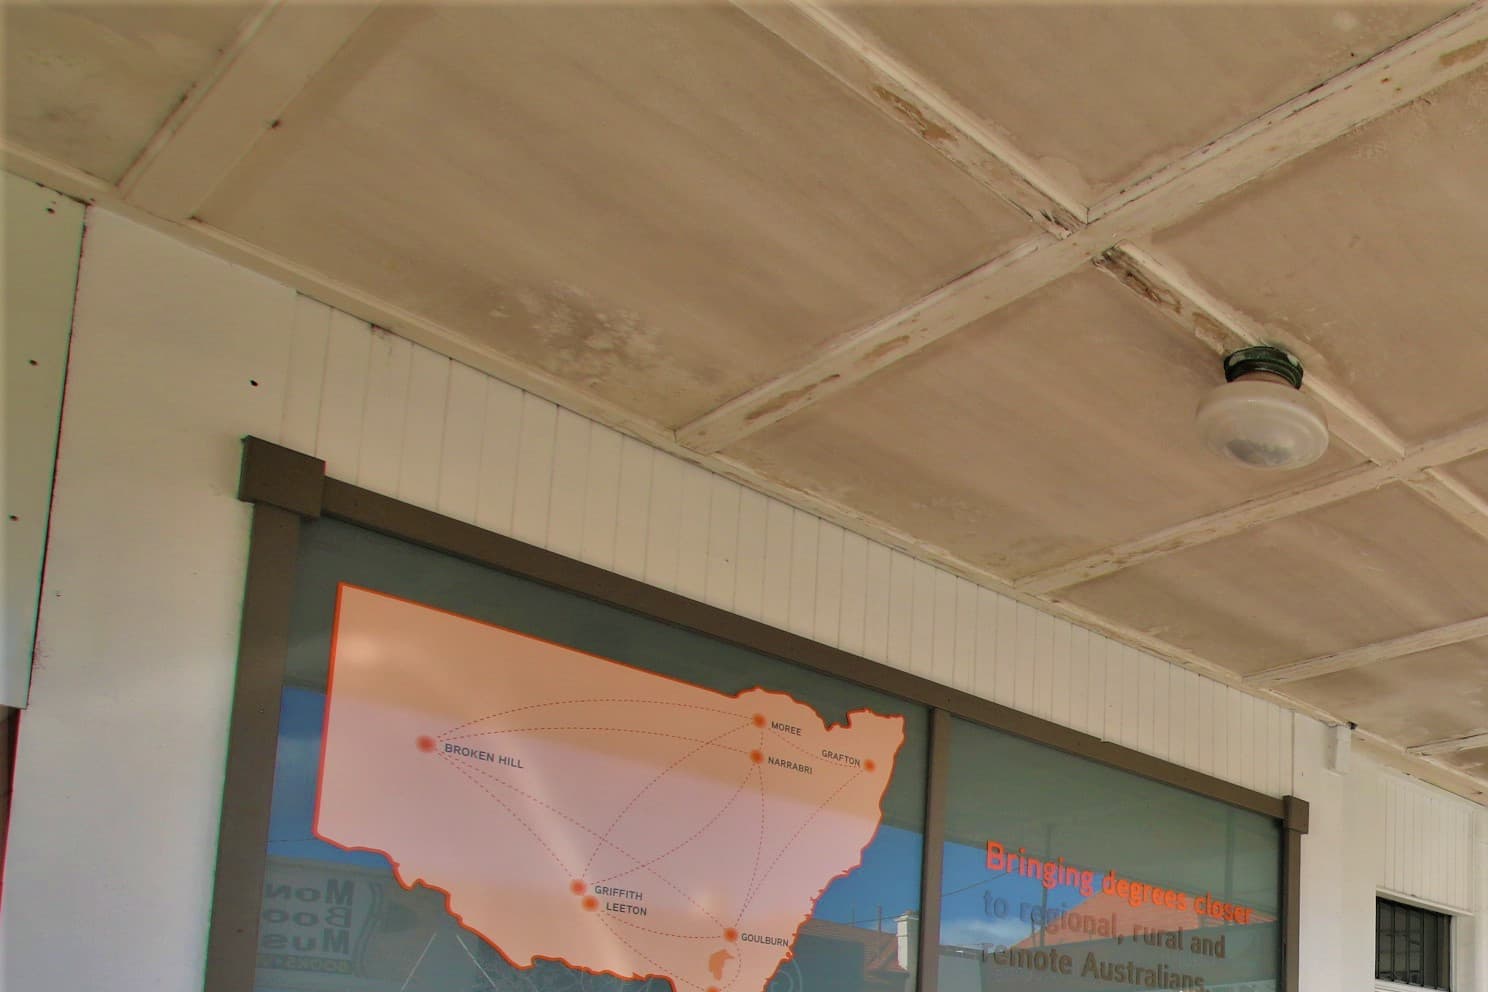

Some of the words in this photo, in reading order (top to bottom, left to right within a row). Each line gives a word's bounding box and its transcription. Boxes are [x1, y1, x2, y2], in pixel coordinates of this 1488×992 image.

[771, 721, 802, 736] MOREE
[444, 743, 495, 762] BROKEN
[498, 755, 524, 769] HILL
[768, 756, 813, 775] NARRABRI
[821, 749, 861, 768] GRAFTON
[986, 839, 1094, 897] Bringing
[1102, 870, 1188, 911] degrees
[1193, 891, 1254, 925] closer
[594, 885, 643, 901] GRIFFITH
[606, 902, 648, 916] LEETON
[983, 890, 1010, 919] to
[1019, 901, 1125, 946] regional,
[1132, 923, 1184, 951] rural
[1190, 935, 1226, 960] and
[741, 933, 789, 947] GOULBURN
[981, 943, 1072, 976] remote
